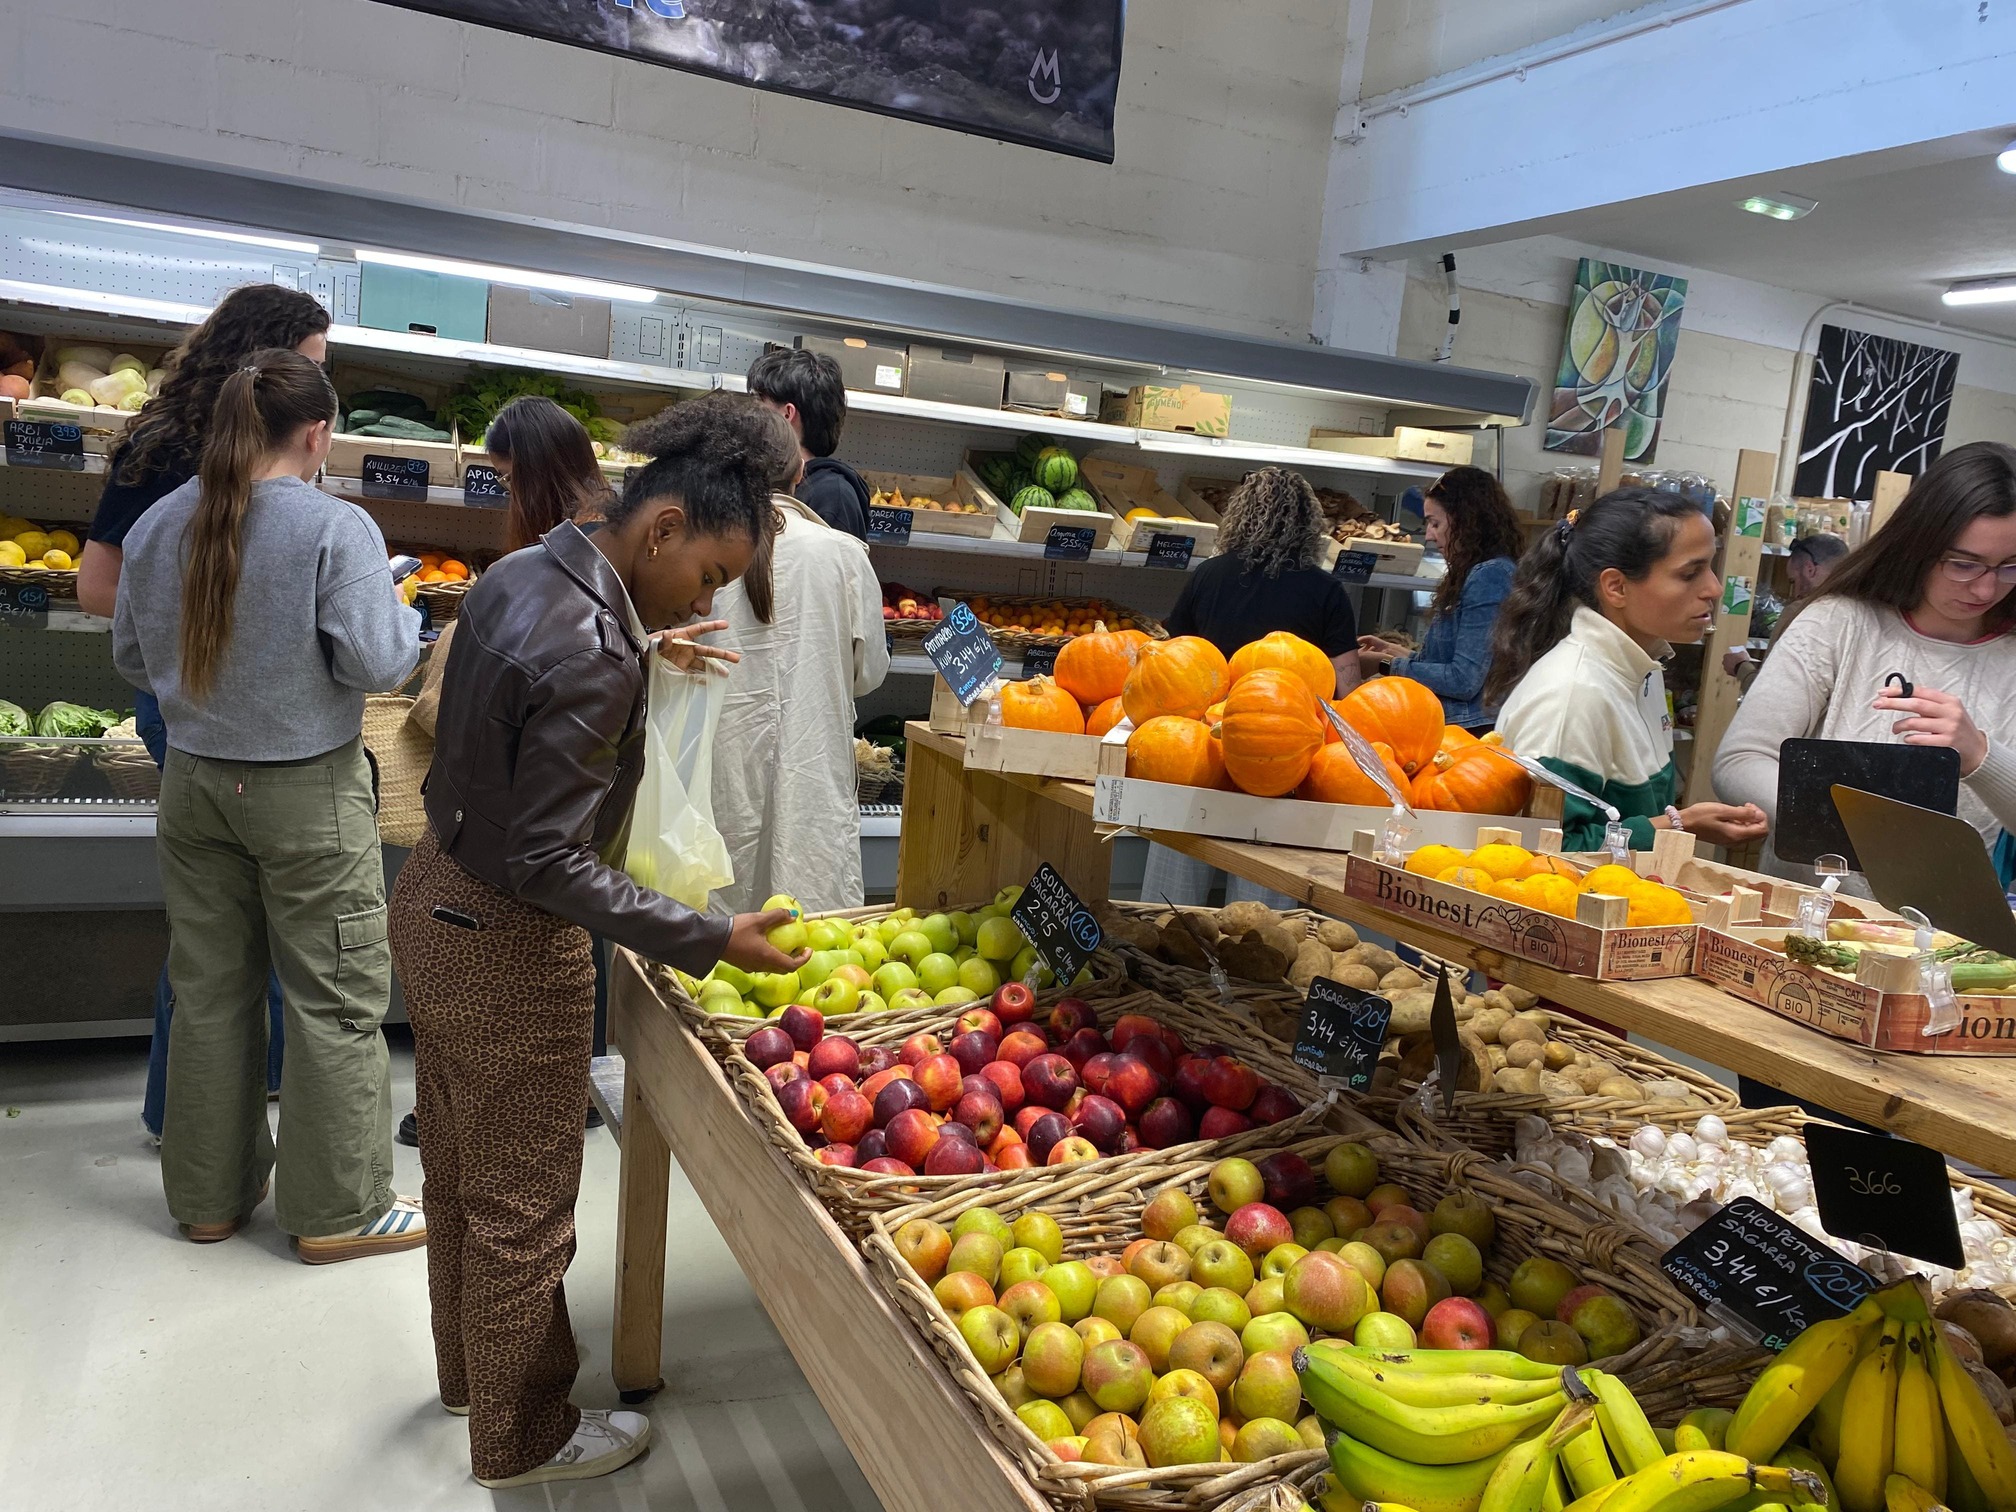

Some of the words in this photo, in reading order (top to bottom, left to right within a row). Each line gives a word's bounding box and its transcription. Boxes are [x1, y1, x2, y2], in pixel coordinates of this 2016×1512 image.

[9, 421, 40, 436] ARBI
[56, 426, 77, 438] 393
[374, 472, 400, 486] 3,54
[470, 481, 497, 496] 2,56
[951, 607, 974, 631] 356
[952, 646, 977, 674] 3,44
[1030, 876, 1070, 930] SAGARRA
[1040, 867, 1080, 914] GOLDEN
[1375, 868, 1474, 929] Bionest
[1072, 915, 1098, 949] 161
[1526, 915, 1559, 934] POST
[1529, 938, 1549, 954] BIO
[1617, 932, 1666, 949] Bionest
[1710, 935, 1759, 968] Bionest
[1784, 998, 1803, 1014] BIO
[1306, 1010, 1335, 1043] 3,44
[1353, 1003, 1390, 1042] 204
[1843, 1166, 1902, 1194] 366
[1719, 1219, 1797, 1274] SAGARRA
[1728, 1203, 1824, 1262] CHOUPETTE
[1704, 1239, 1758, 1284] 3,44
